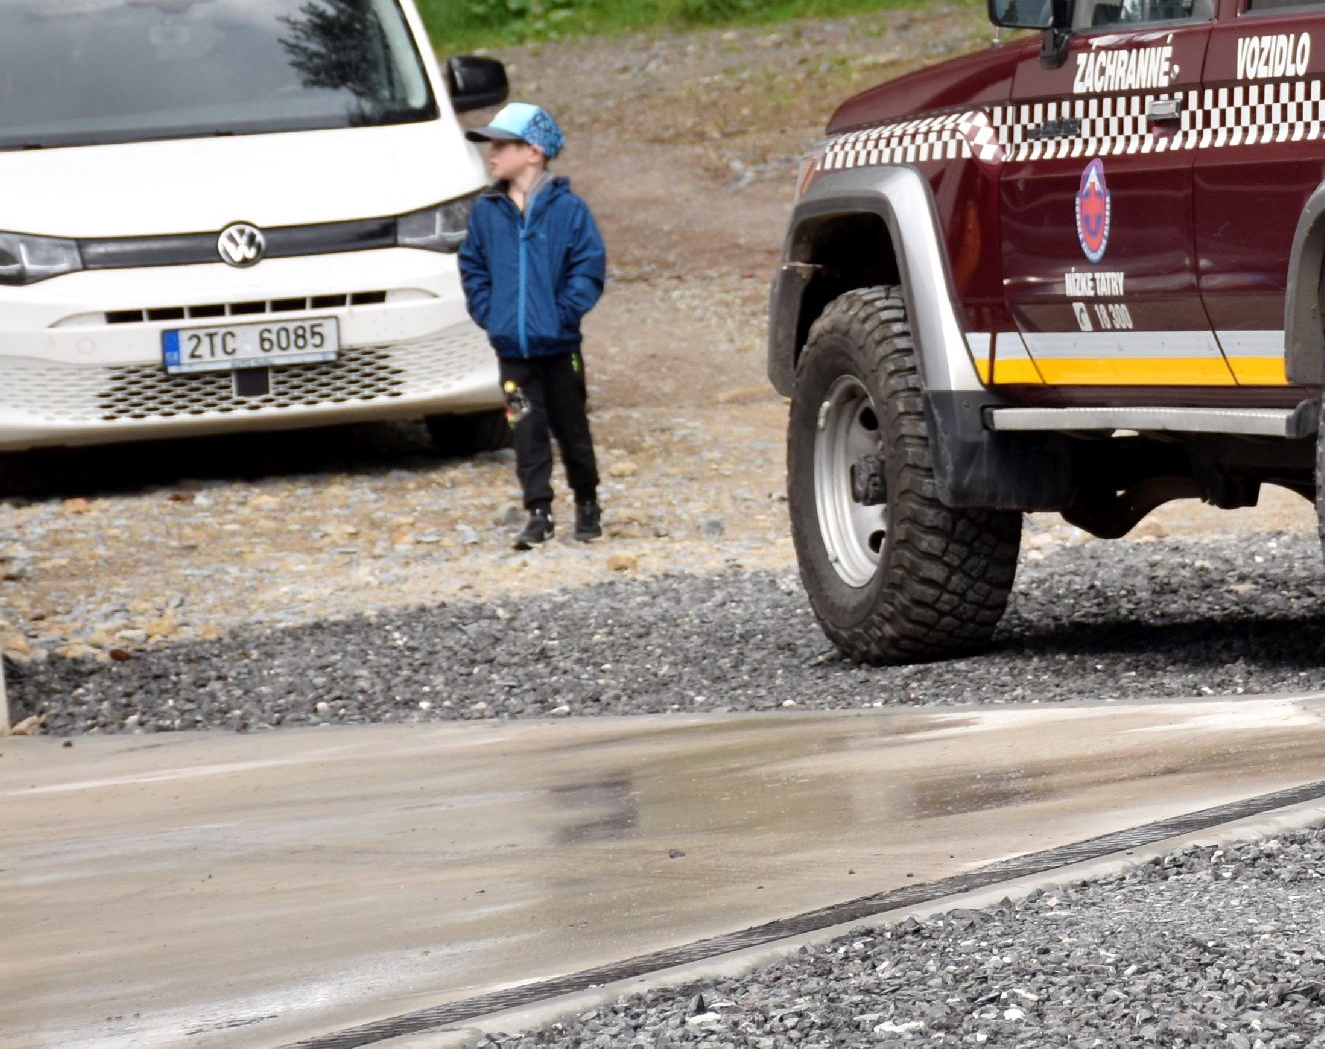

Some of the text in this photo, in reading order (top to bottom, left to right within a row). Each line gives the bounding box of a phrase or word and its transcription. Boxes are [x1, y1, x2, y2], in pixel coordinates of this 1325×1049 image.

[1073, 32, 1311, 94] ZÁCHRANNÉ VOZIDLO
[1094, 271, 1125, 297] TATRY
[1094, 303, 1134, 330] 18 300
[188, 330, 237, 360] 2TC
[258, 322, 325, 353] 6085
